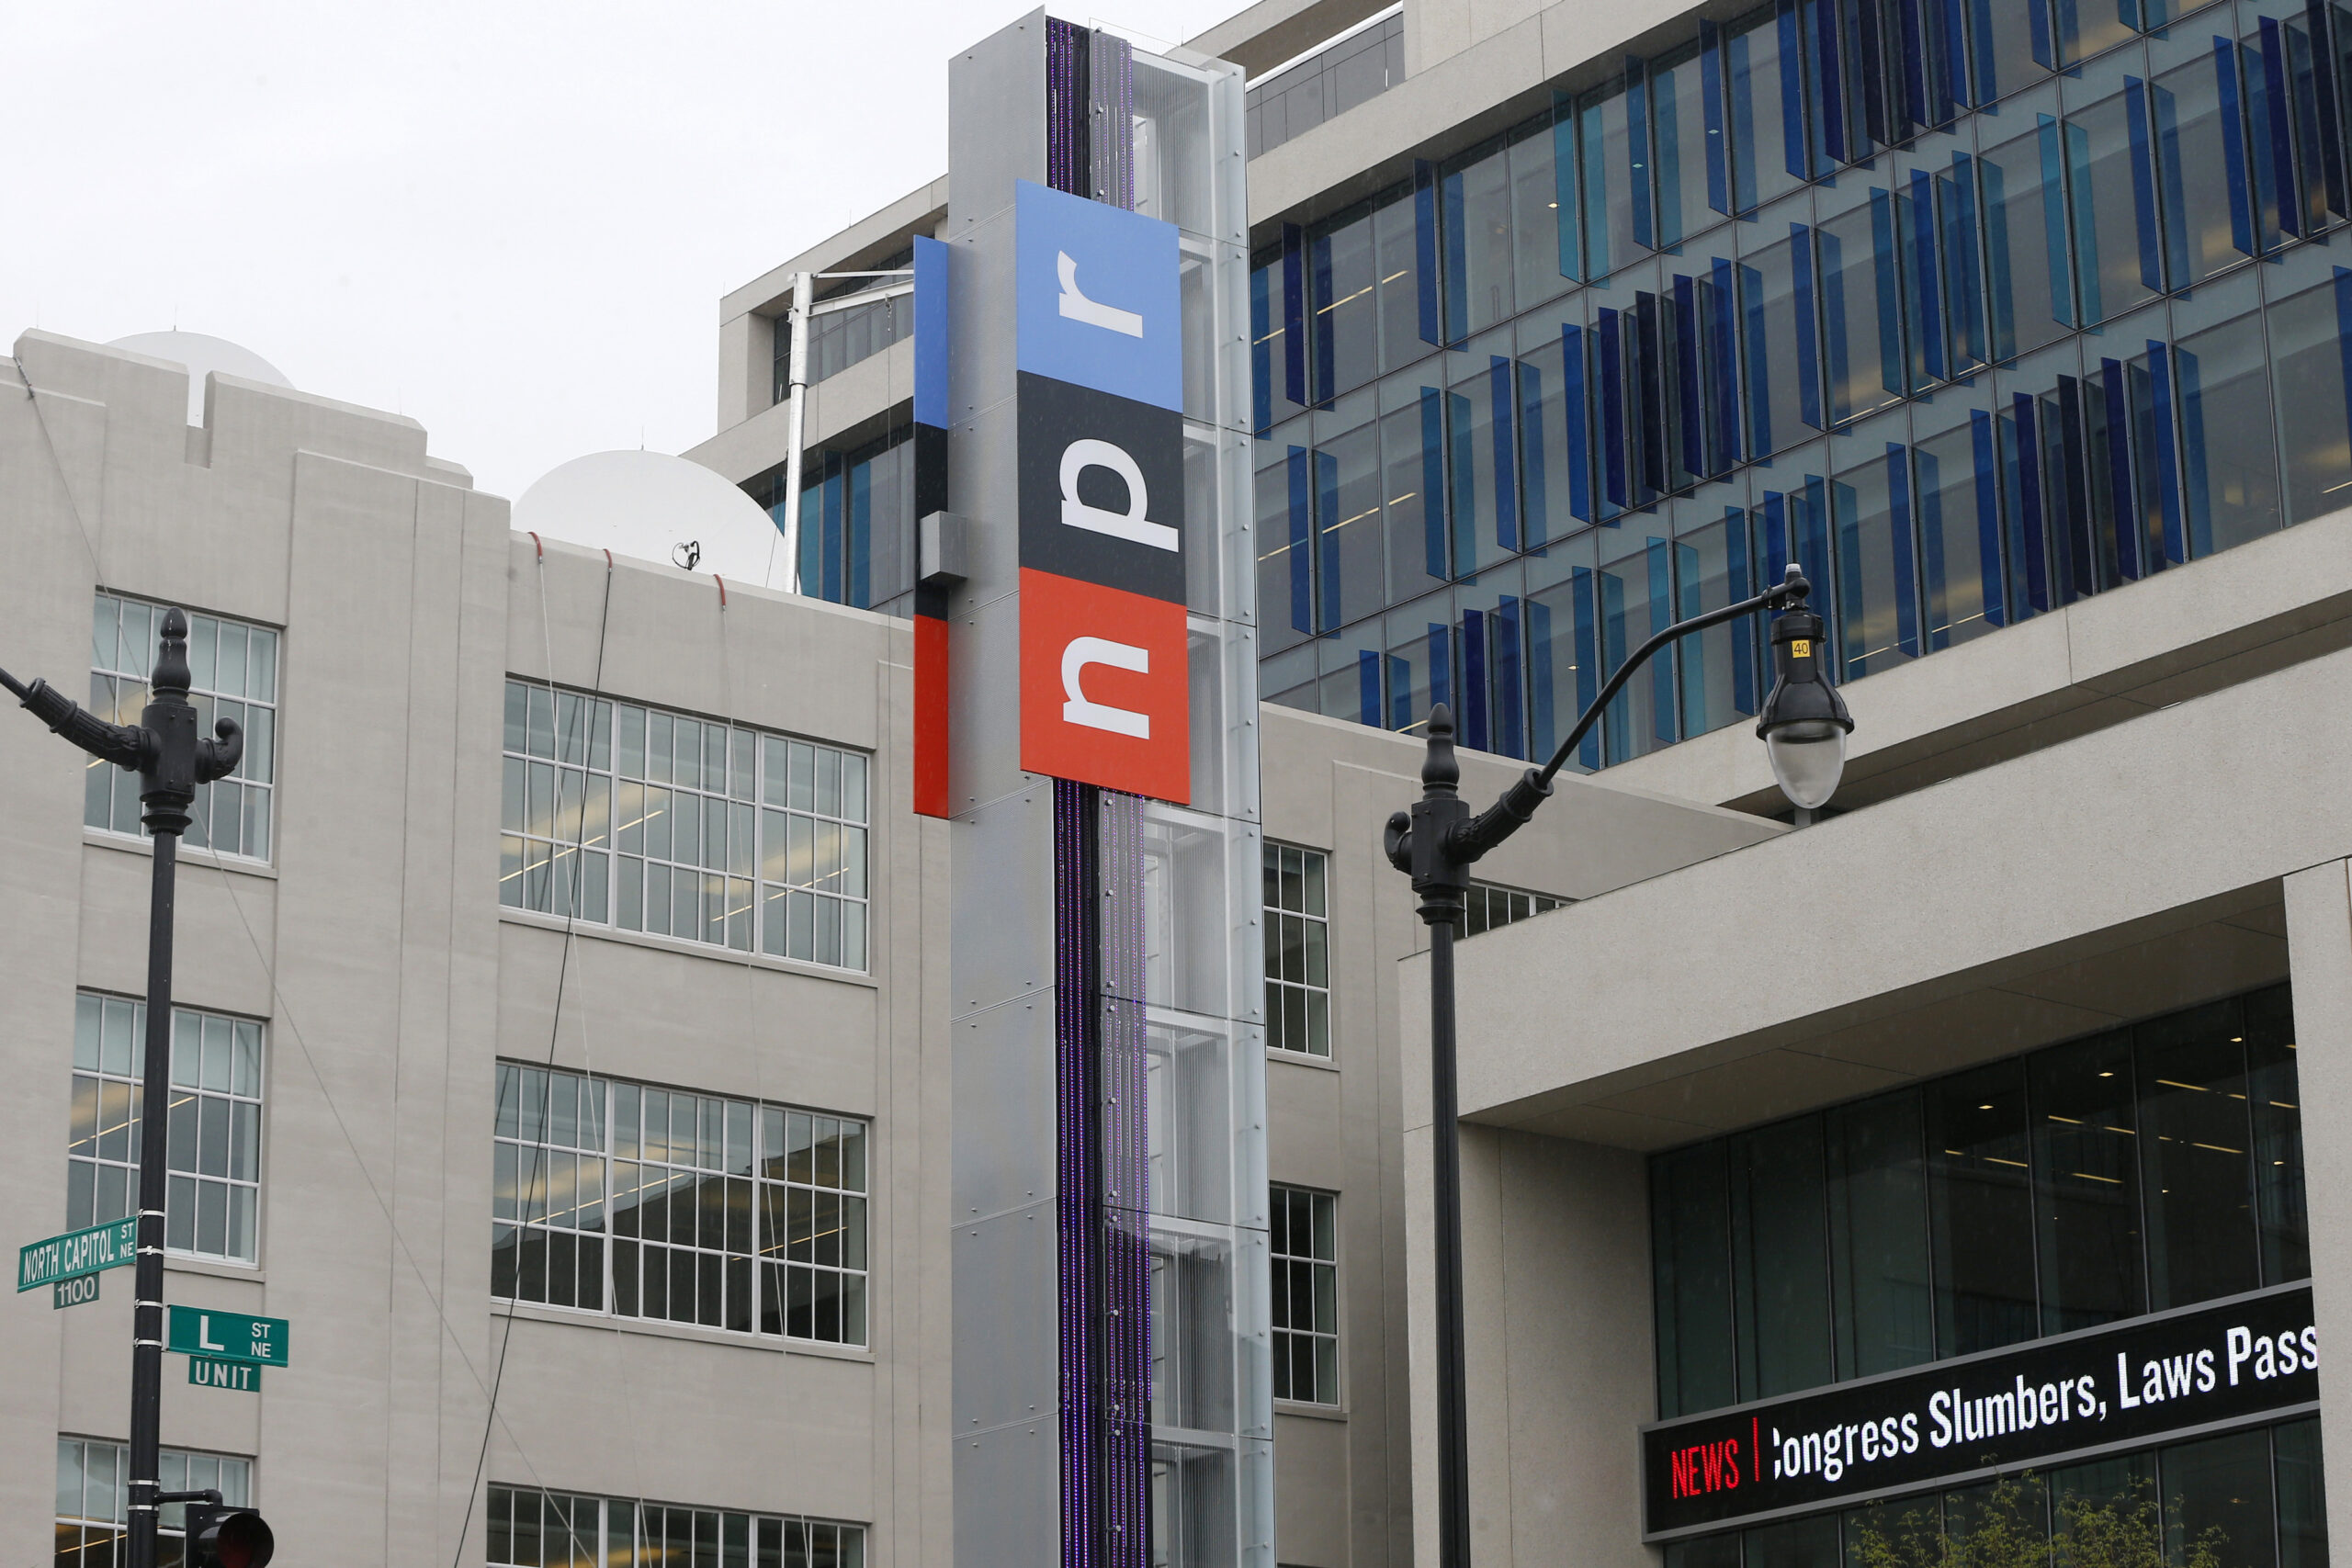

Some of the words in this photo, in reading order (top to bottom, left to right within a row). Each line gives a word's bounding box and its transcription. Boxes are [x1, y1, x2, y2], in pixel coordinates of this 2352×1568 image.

[1056, 249, 1180, 740] npr
[1794, 643, 1808, 654] 40
[120, 1223, 134, 1239] ST
[23, 1242, 60, 1284] NORTH
[64, 1229, 115, 1272] CAPITOL
[119, 1242, 134, 1258] NE
[57, 1276, 96, 1305] 1100
[199, 1314, 225, 1351] L
[251, 1322, 271, 1338] ST
[251, 1341, 271, 1358] NE
[195, 1360, 252, 1390] UNIT
[1671, 1438, 1740, 1499] NEWS
[1928, 1374, 2108, 1449] Slumbers,
[2118, 1348, 2216, 1410] Laws
[2226, 1325, 2319, 1386] Pass
